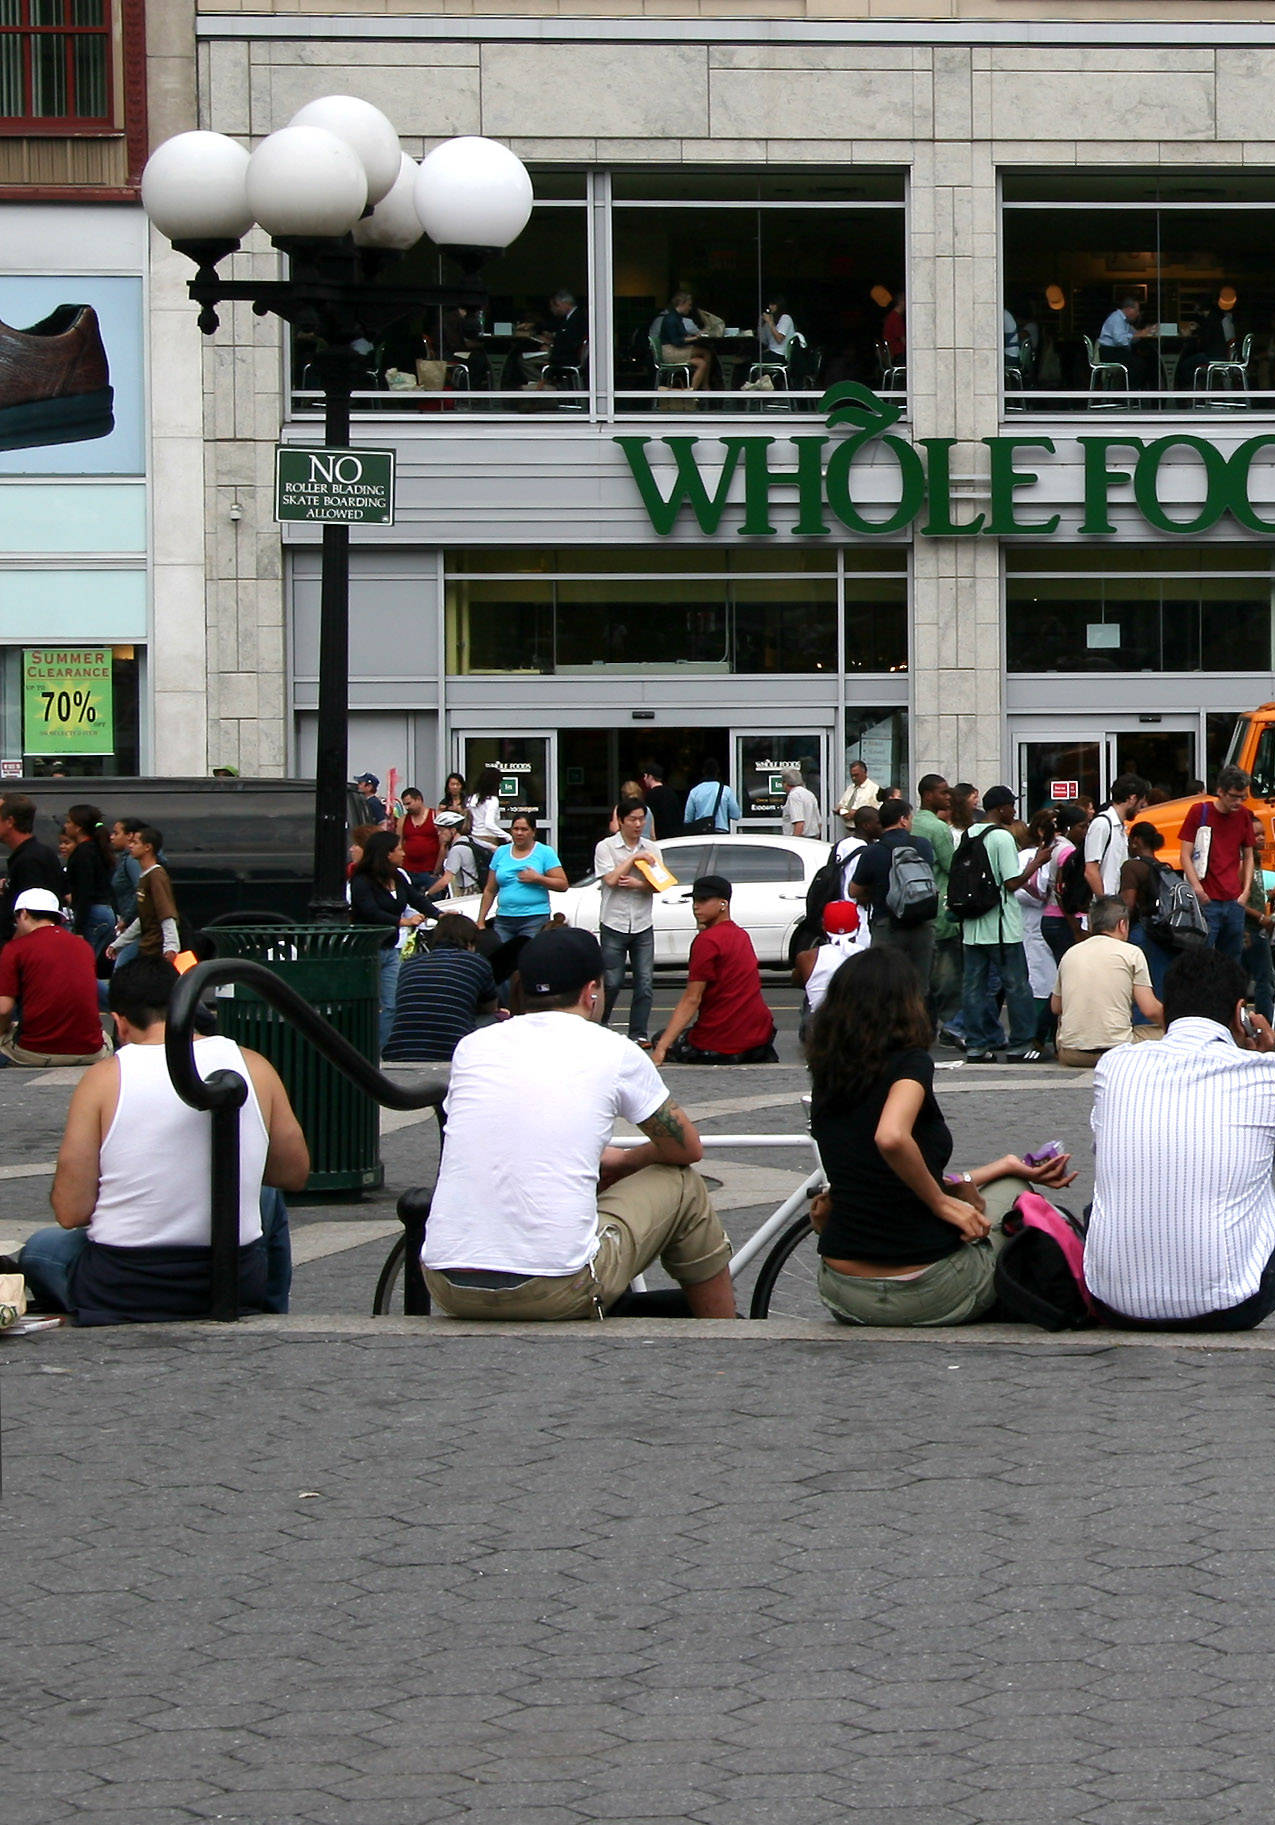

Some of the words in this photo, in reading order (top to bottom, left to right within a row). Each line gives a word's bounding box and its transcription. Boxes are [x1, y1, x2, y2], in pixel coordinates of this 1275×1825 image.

[308, 454, 363, 484] NO
[612, 415, 1061, 537] WHOLE
[285, 482, 329, 494] ROLLER
[332, 484, 385, 496] BLADING
[282, 494, 320, 506] SKATE
[323, 496, 387, 508] BOARDING
[306, 508, 364, 520] ALLOWED
[31, 650, 105, 664] SUMMER
[26, 666, 110, 678] CLEARANCE
[41, 690, 97, 723] 70%
